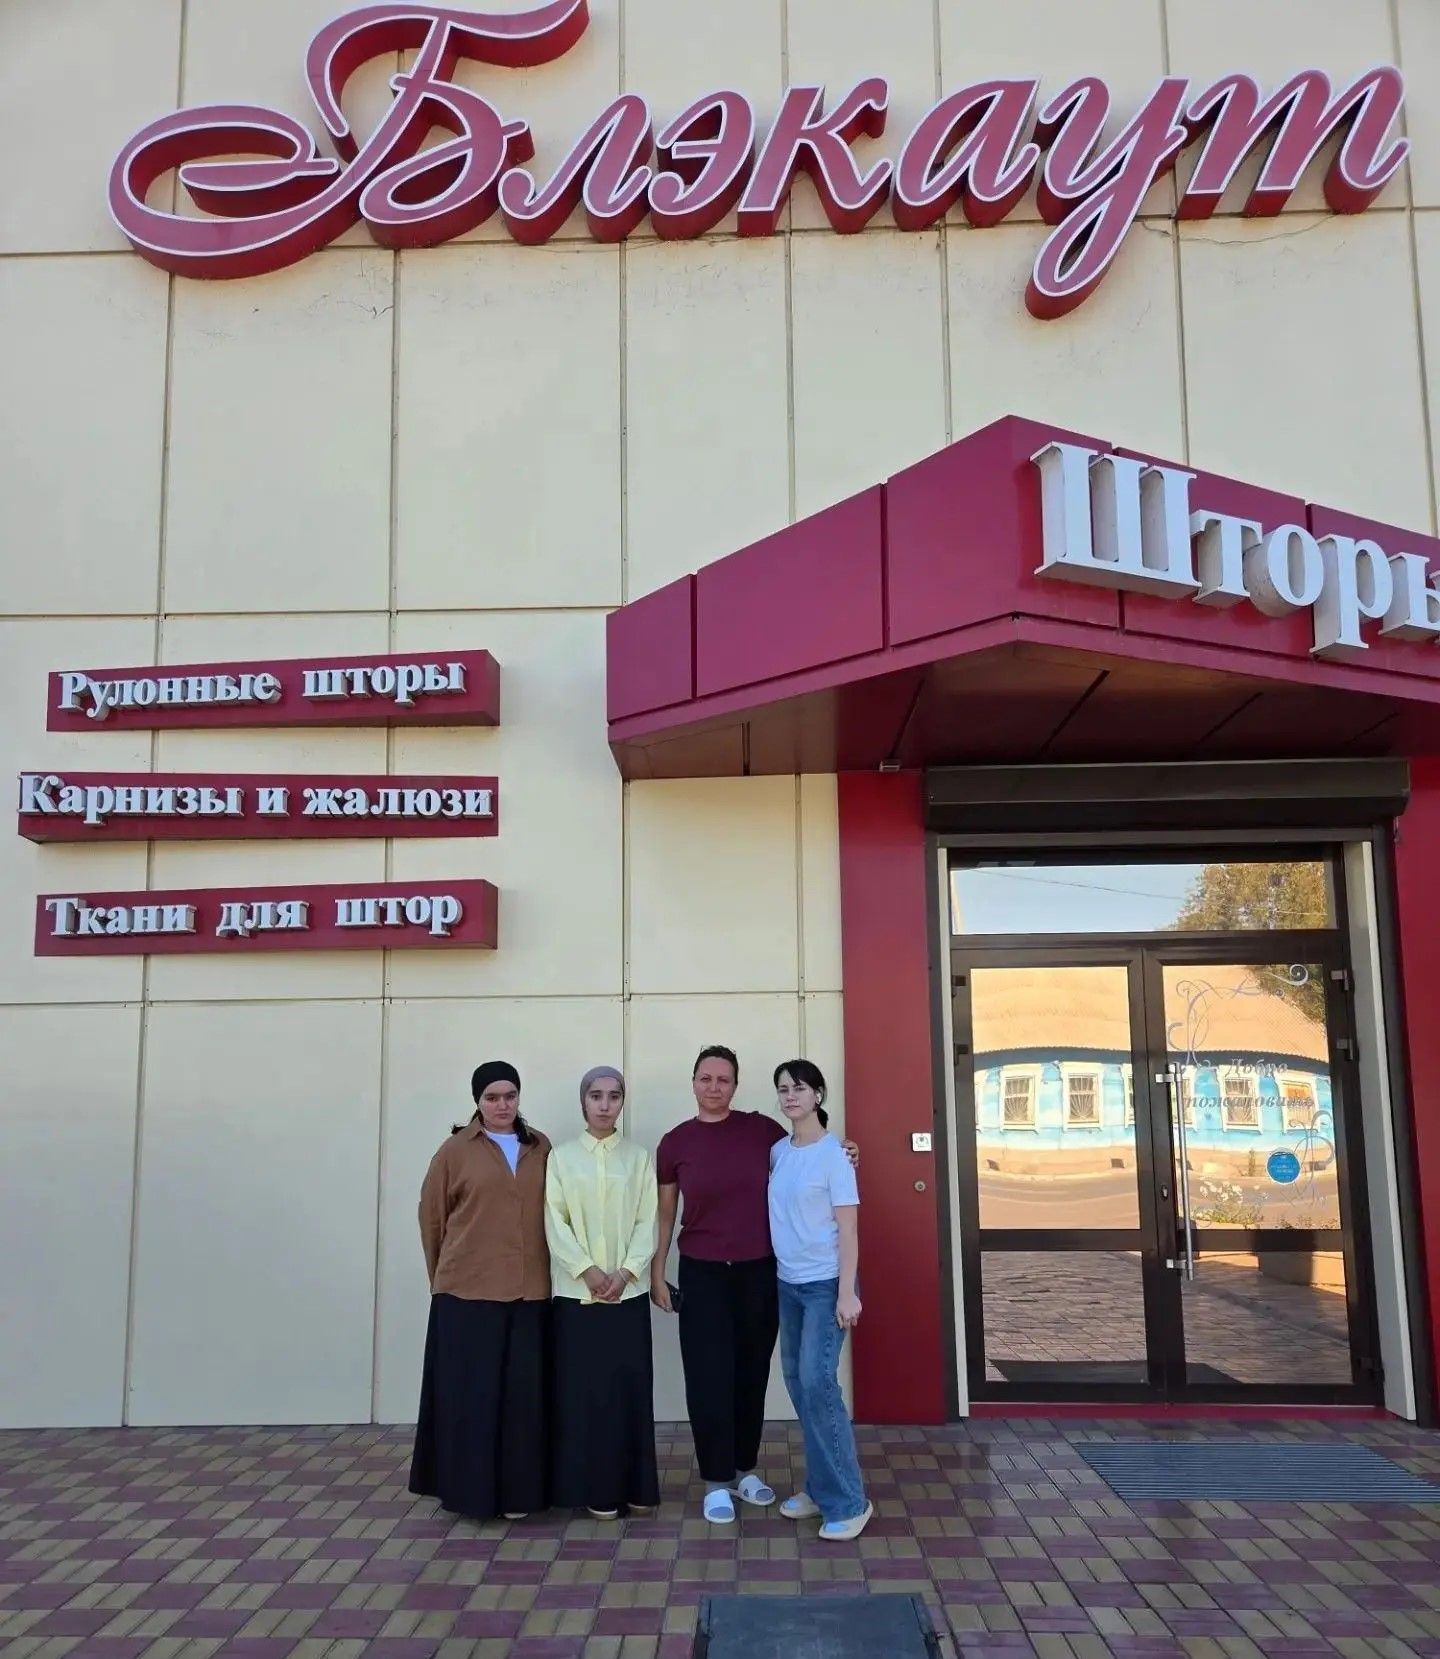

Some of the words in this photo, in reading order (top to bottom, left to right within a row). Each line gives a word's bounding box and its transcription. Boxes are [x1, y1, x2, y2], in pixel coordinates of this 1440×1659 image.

[108, 0, 1410, 316] Блэкаут
[58, 671, 282, 720] Рулонные
[302, 661, 467, 707] шторы
[18, 774, 244, 825] Карнизы
[256, 786, 290, 817] и
[302, 786, 494, 819] жалюзи
[45, 897, 197, 937] Ткани
[215, 899, 310, 938] для
[335, 894, 463, 936] штор
[1224, 1058, 1289, 1078] Добро
